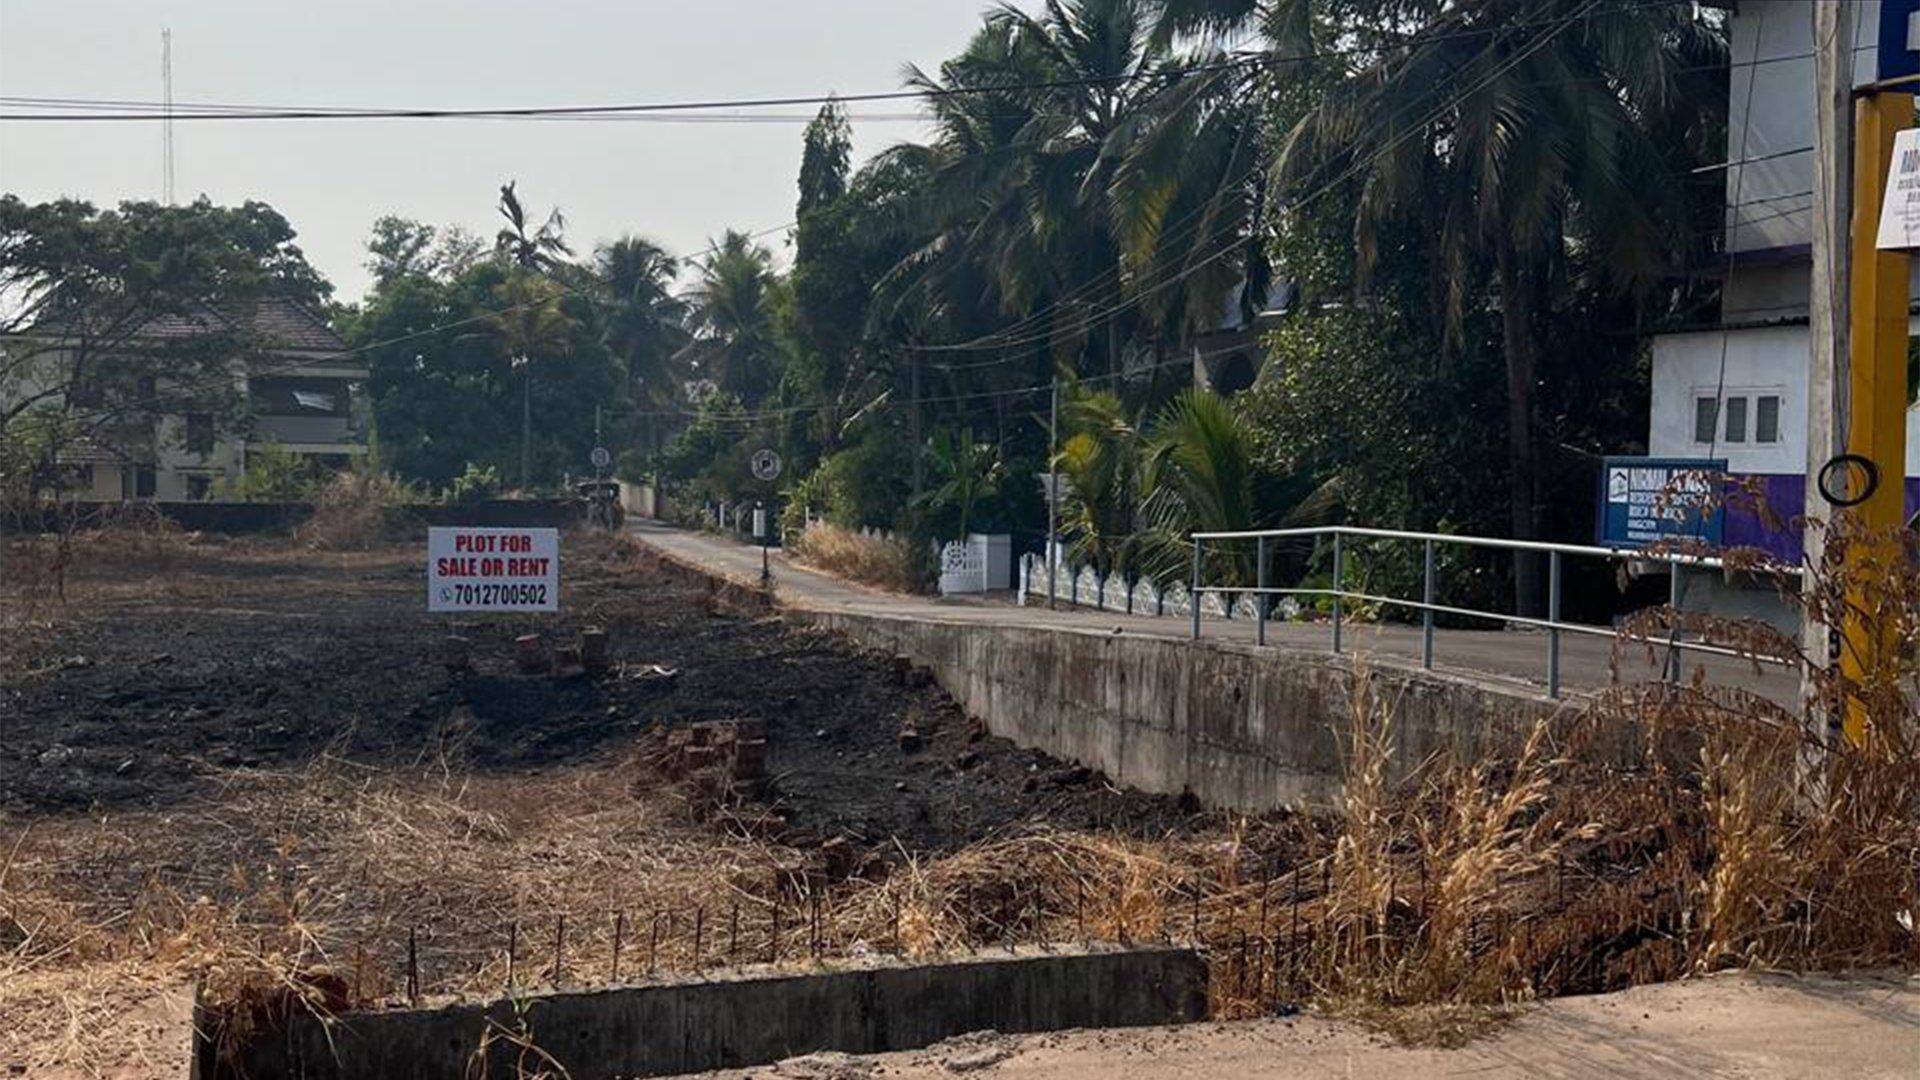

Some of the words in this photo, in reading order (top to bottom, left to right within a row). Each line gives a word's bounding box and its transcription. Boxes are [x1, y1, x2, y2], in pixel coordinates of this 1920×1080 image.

[455, 535, 496, 553] PLOT
[500, 535, 532, 553] FOR
[437, 558, 477, 577] SALE
[480, 558, 503, 577] OR
[508, 558, 549, 577] RENT
[455, 584, 547, 605] 7012700502
